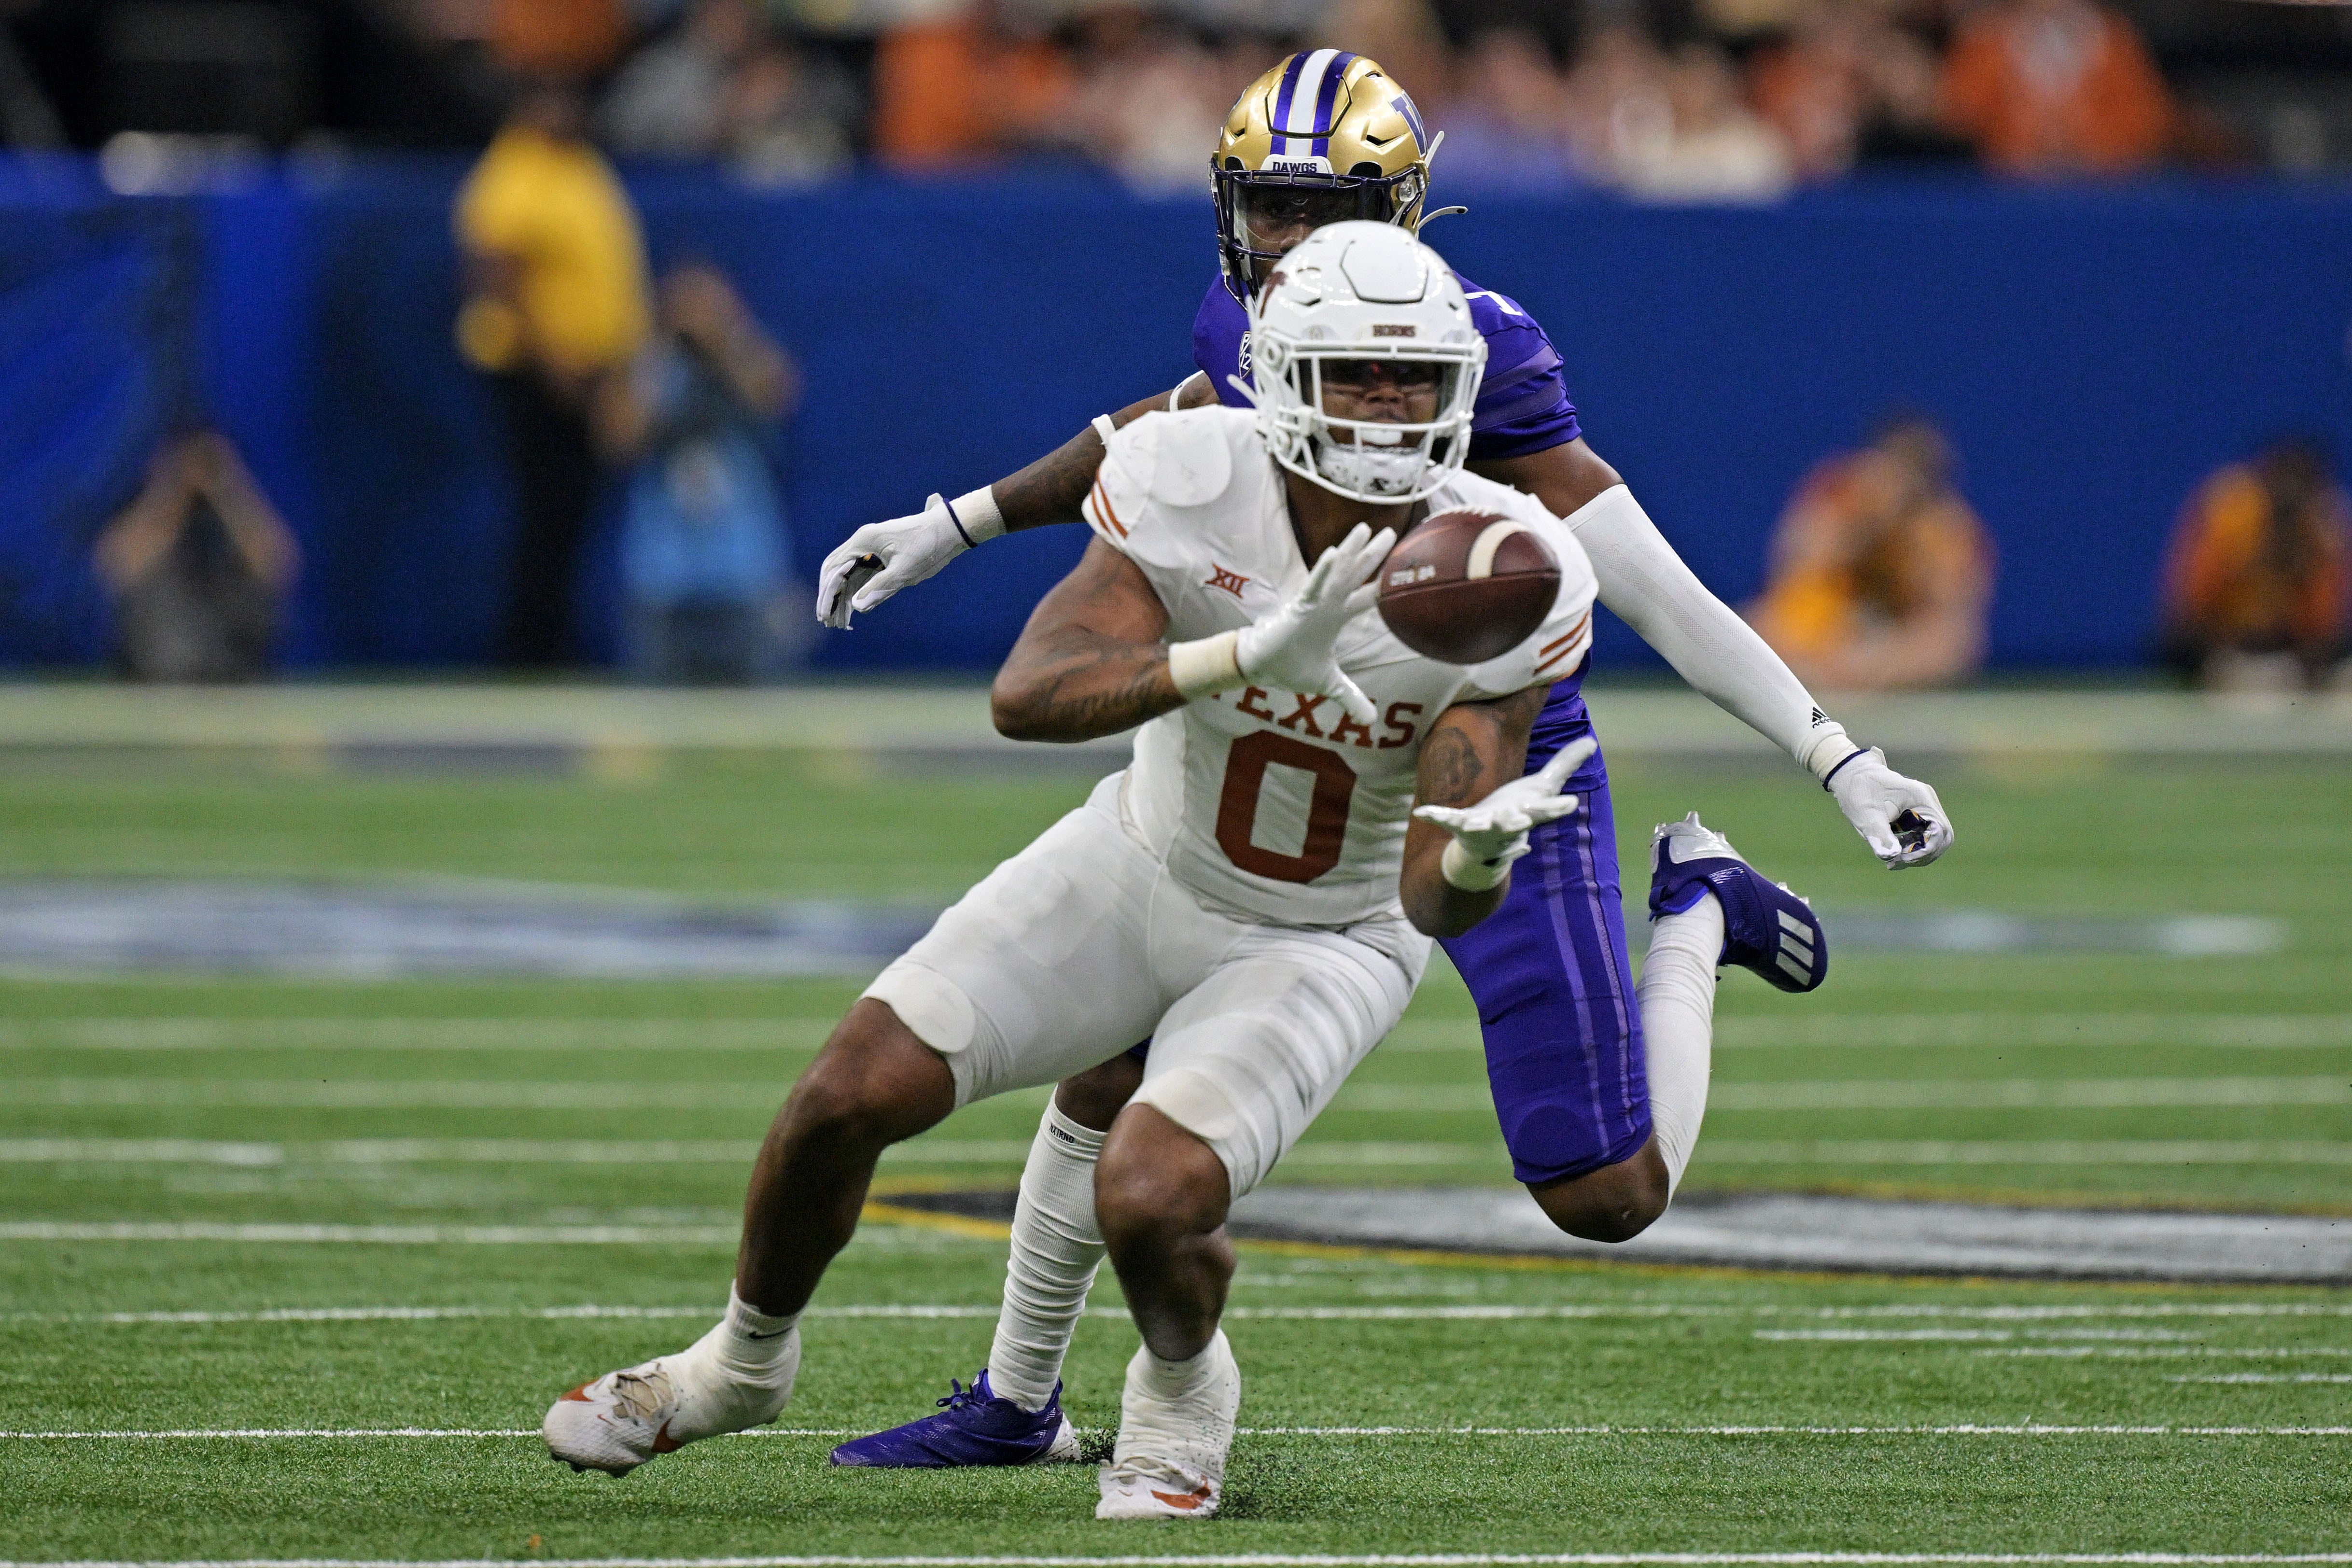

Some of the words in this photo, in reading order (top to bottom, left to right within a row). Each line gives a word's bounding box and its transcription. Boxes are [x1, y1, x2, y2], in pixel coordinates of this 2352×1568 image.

[1273, 161, 1317, 172] DAWGS
[1205, 563, 1249, 599] XII
[1211, 686, 1424, 749] EXAS
[1215, 729, 1357, 884] 0
